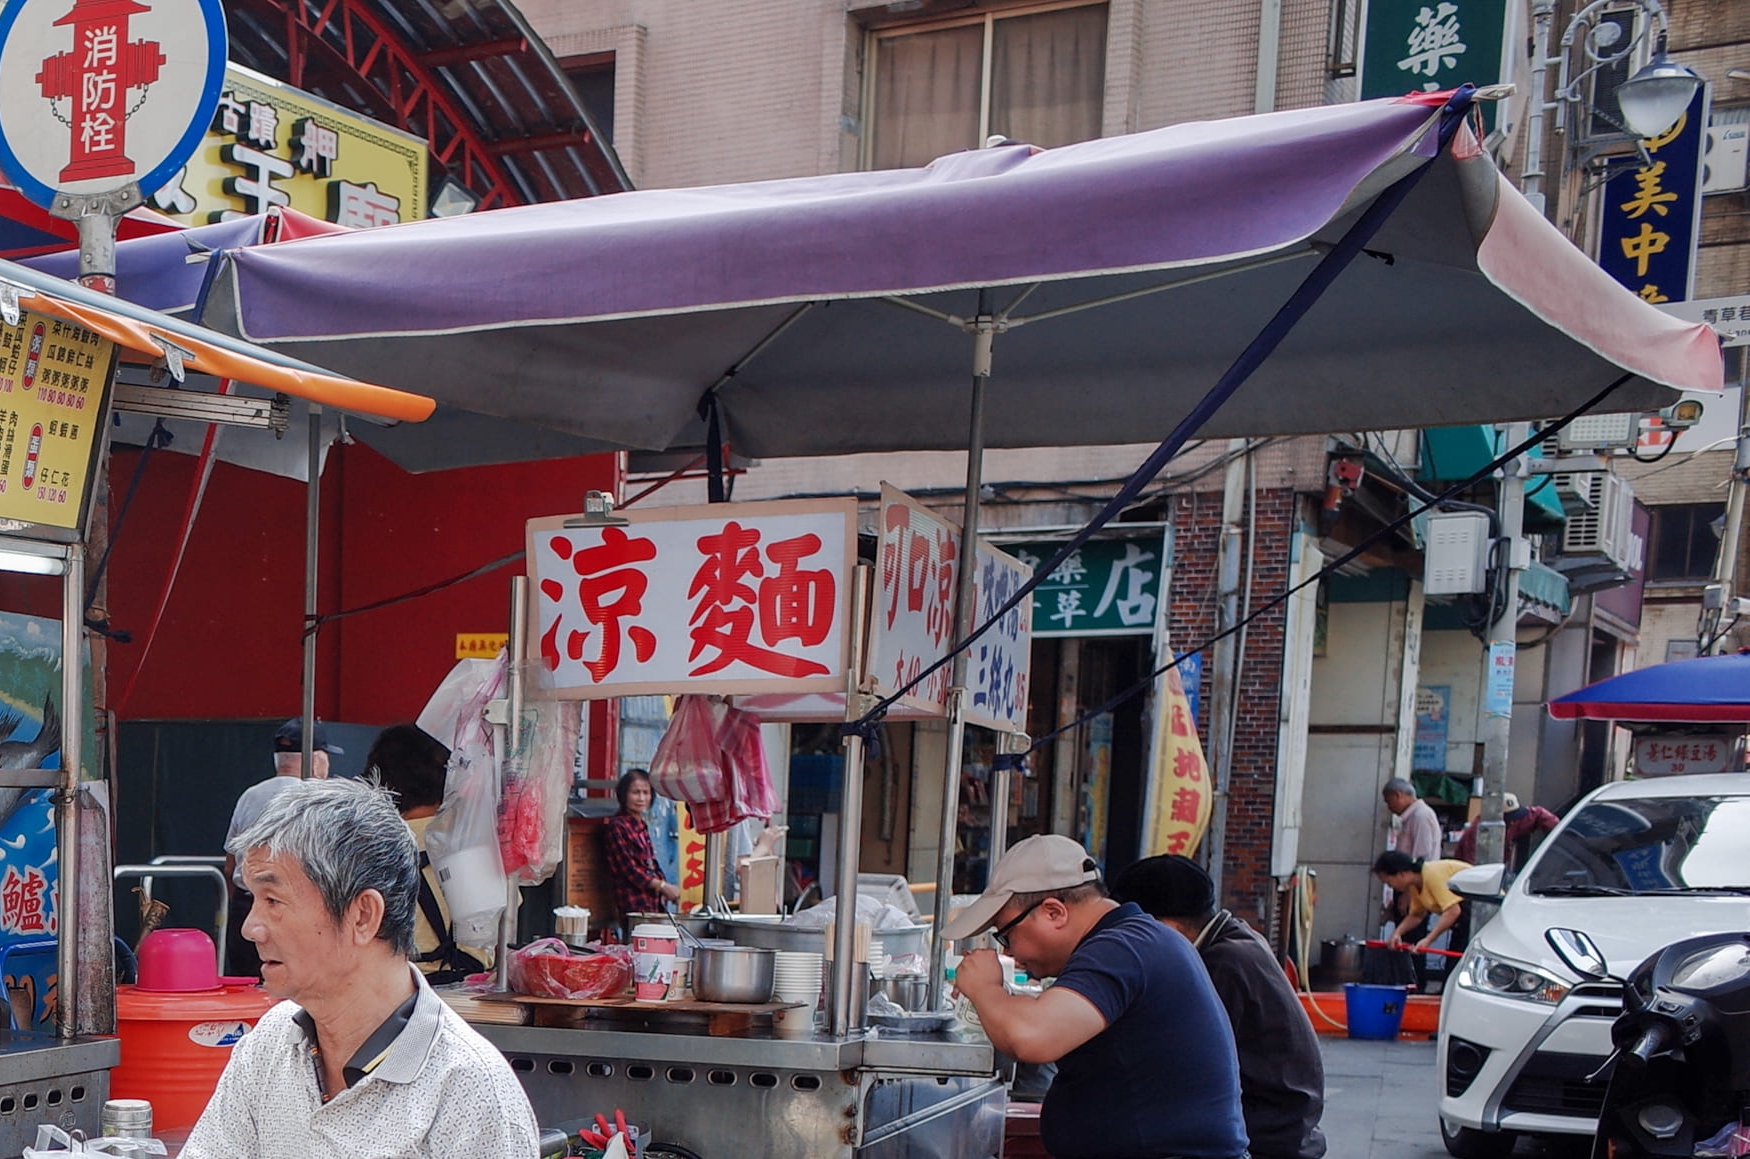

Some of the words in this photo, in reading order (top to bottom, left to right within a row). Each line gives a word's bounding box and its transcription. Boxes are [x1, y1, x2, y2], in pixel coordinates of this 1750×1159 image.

[1396, 2, 1467, 76] 藥
[81, 25, 117, 153] 消防栓
[48, 390, 56, 402] 80
[57, 392, 65, 404] 80
[66, 394, 75, 407] 80
[76, 397, 84, 409] 60
[58, 490, 66, 503] 60
[540, 521, 836, 683] 涼麵
[883, 504, 977, 657] 可口涼
[1093, 543, 1158, 627] 店
